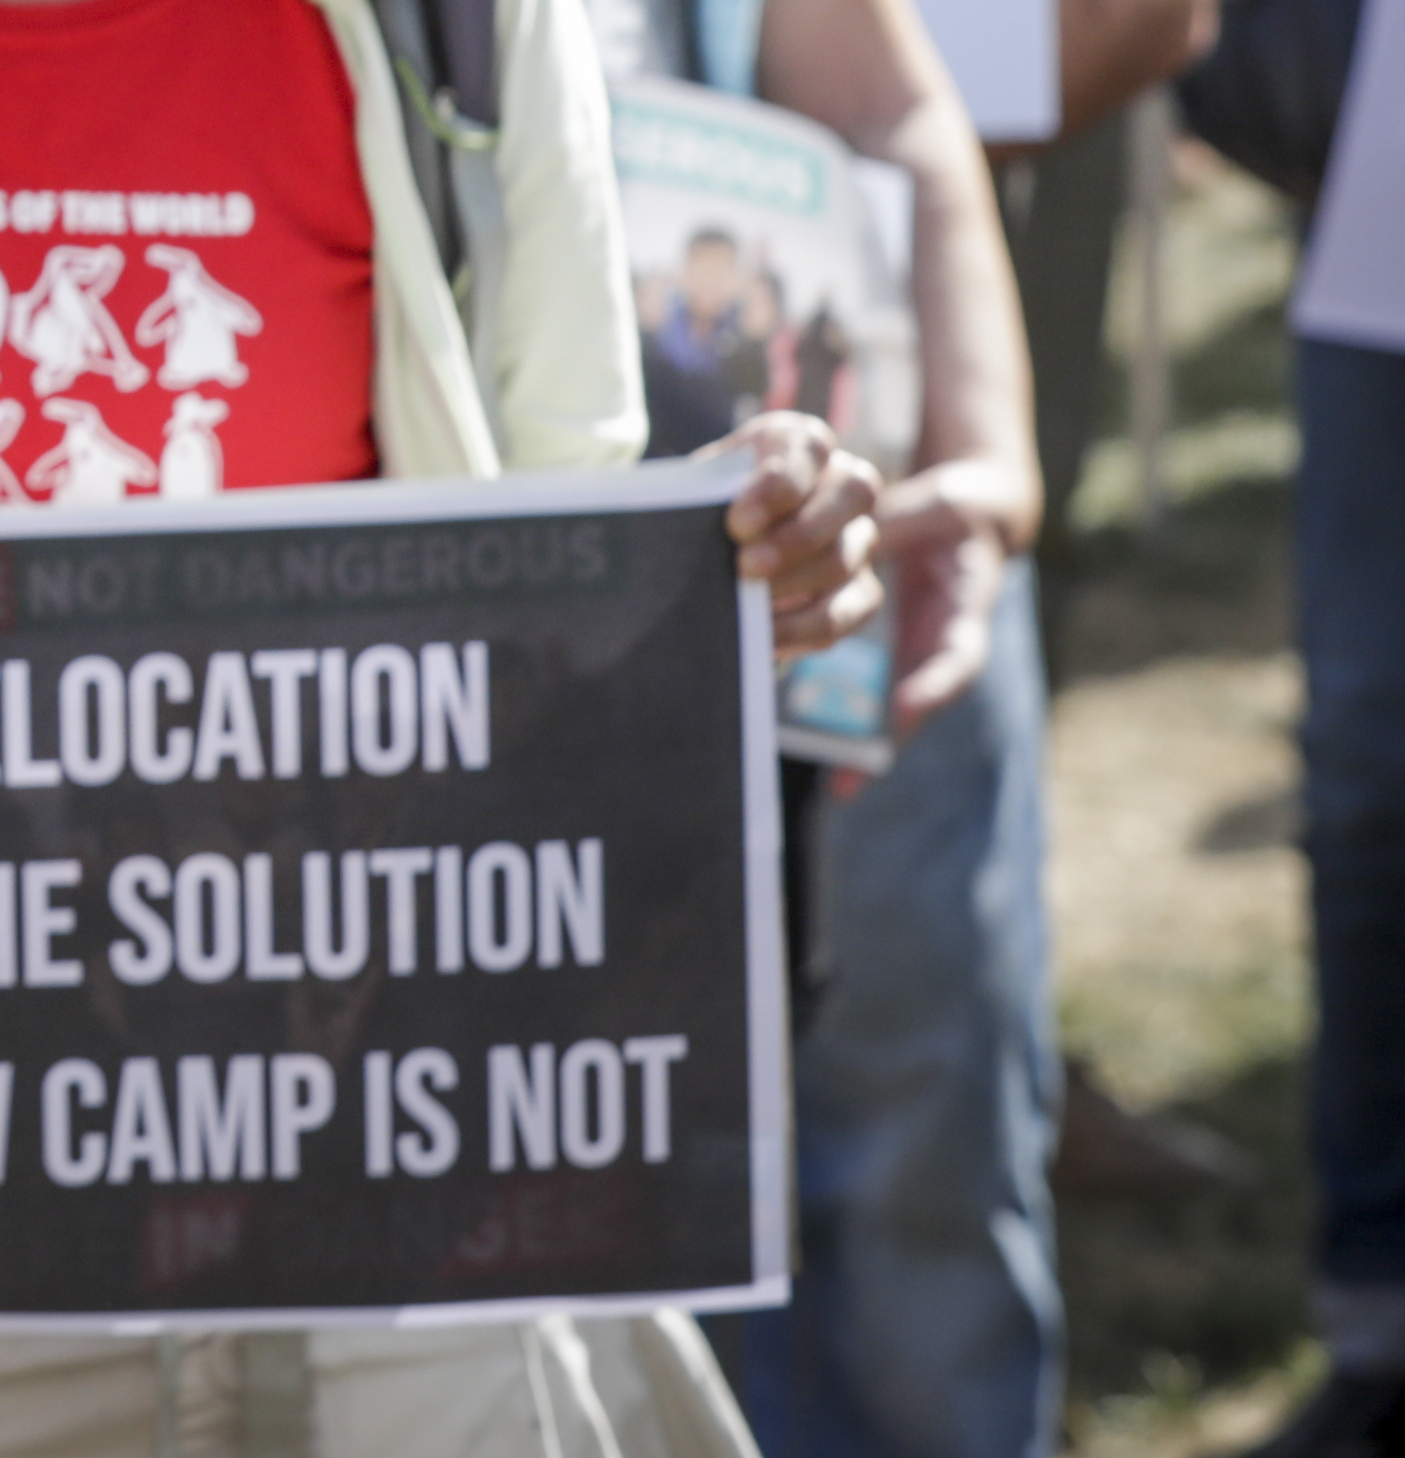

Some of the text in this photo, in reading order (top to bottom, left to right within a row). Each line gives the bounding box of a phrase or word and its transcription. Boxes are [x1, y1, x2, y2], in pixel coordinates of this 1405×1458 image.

[11, 188, 57, 233] OF
[61, 189, 128, 235] THE
[129, 190, 256, 237] WORLD
[108, 837, 605, 986] SOLUTION
[41, 1052, 337, 1189] CAMP
[364, 1047, 462, 1180] IS
[487, 1033, 689, 1174] NOT
